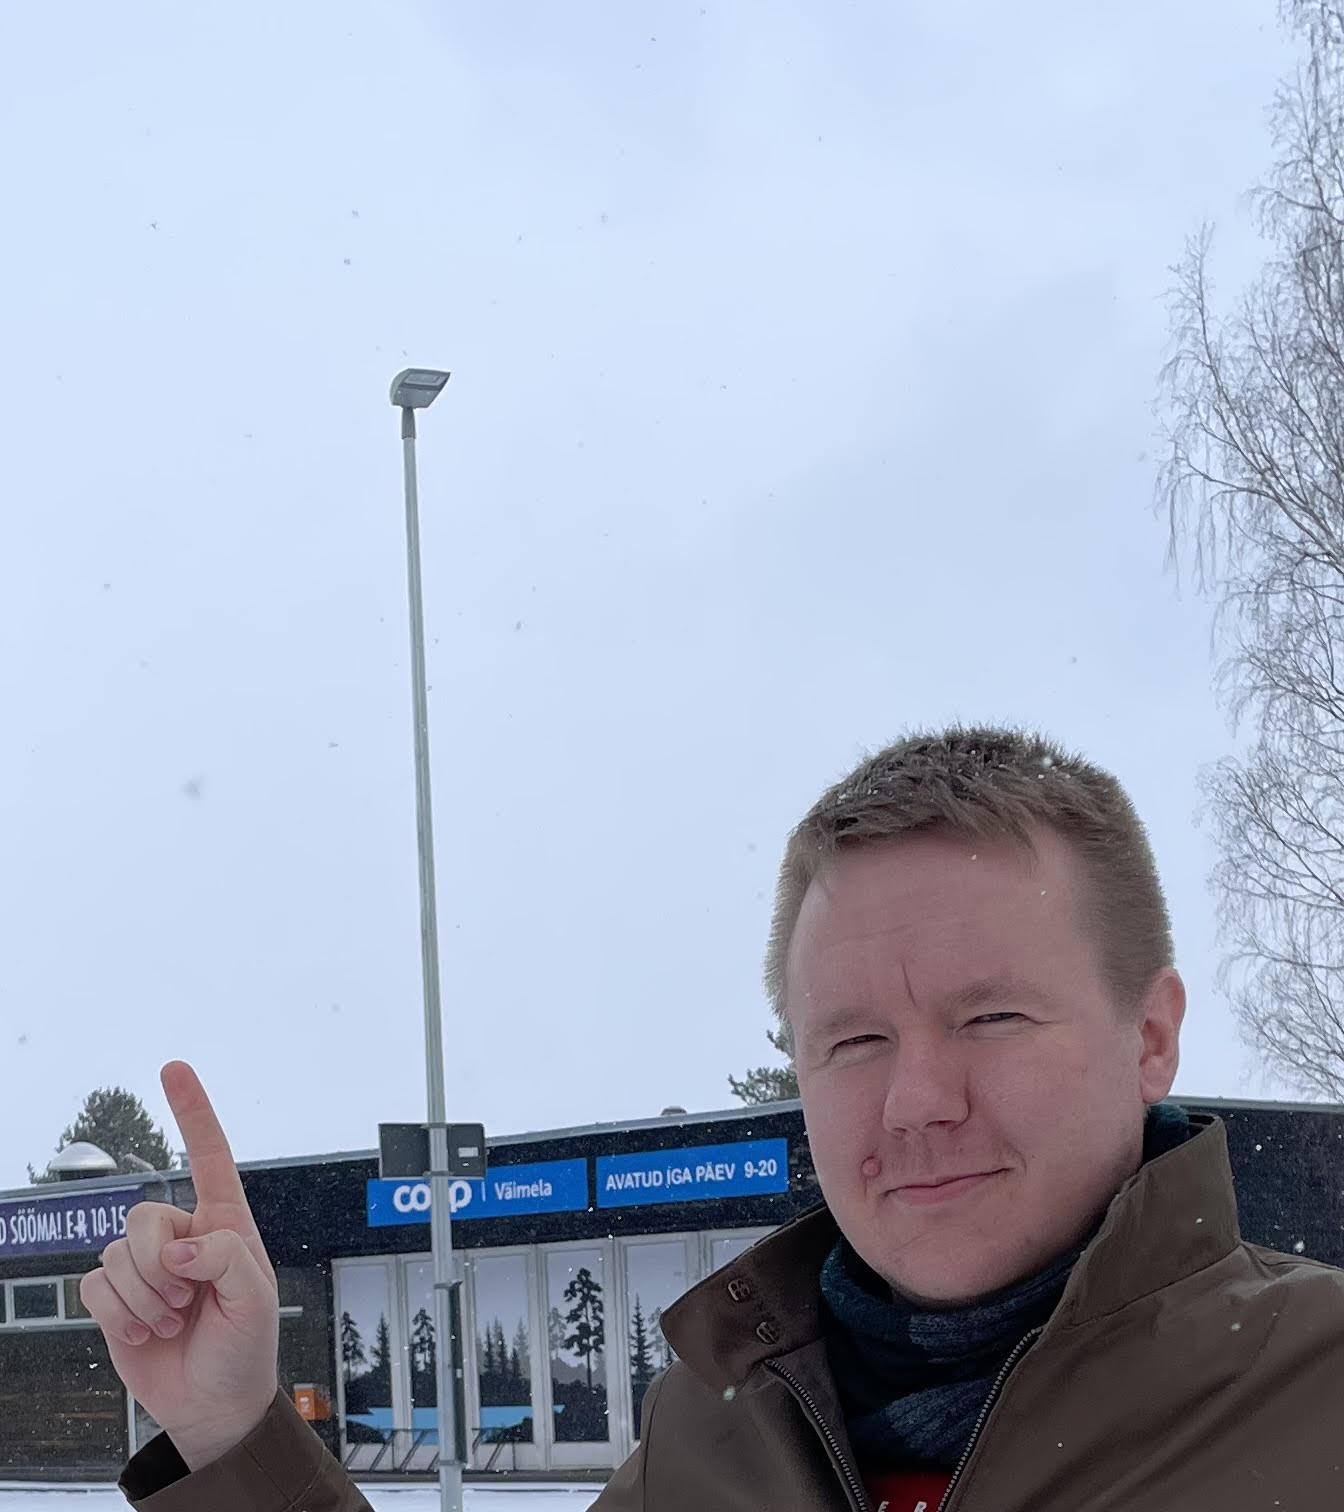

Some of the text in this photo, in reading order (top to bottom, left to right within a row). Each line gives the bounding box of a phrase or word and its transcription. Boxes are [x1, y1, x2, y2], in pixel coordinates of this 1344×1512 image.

[606, 1159, 777, 1191] AVATUD IGA PÄEV 9-20
[393, 1179, 552, 1213] cop Väimela
[9, 1208, 62, 1244] SÖÖMA!
[91, 1205, 127, 1237] 10-15
